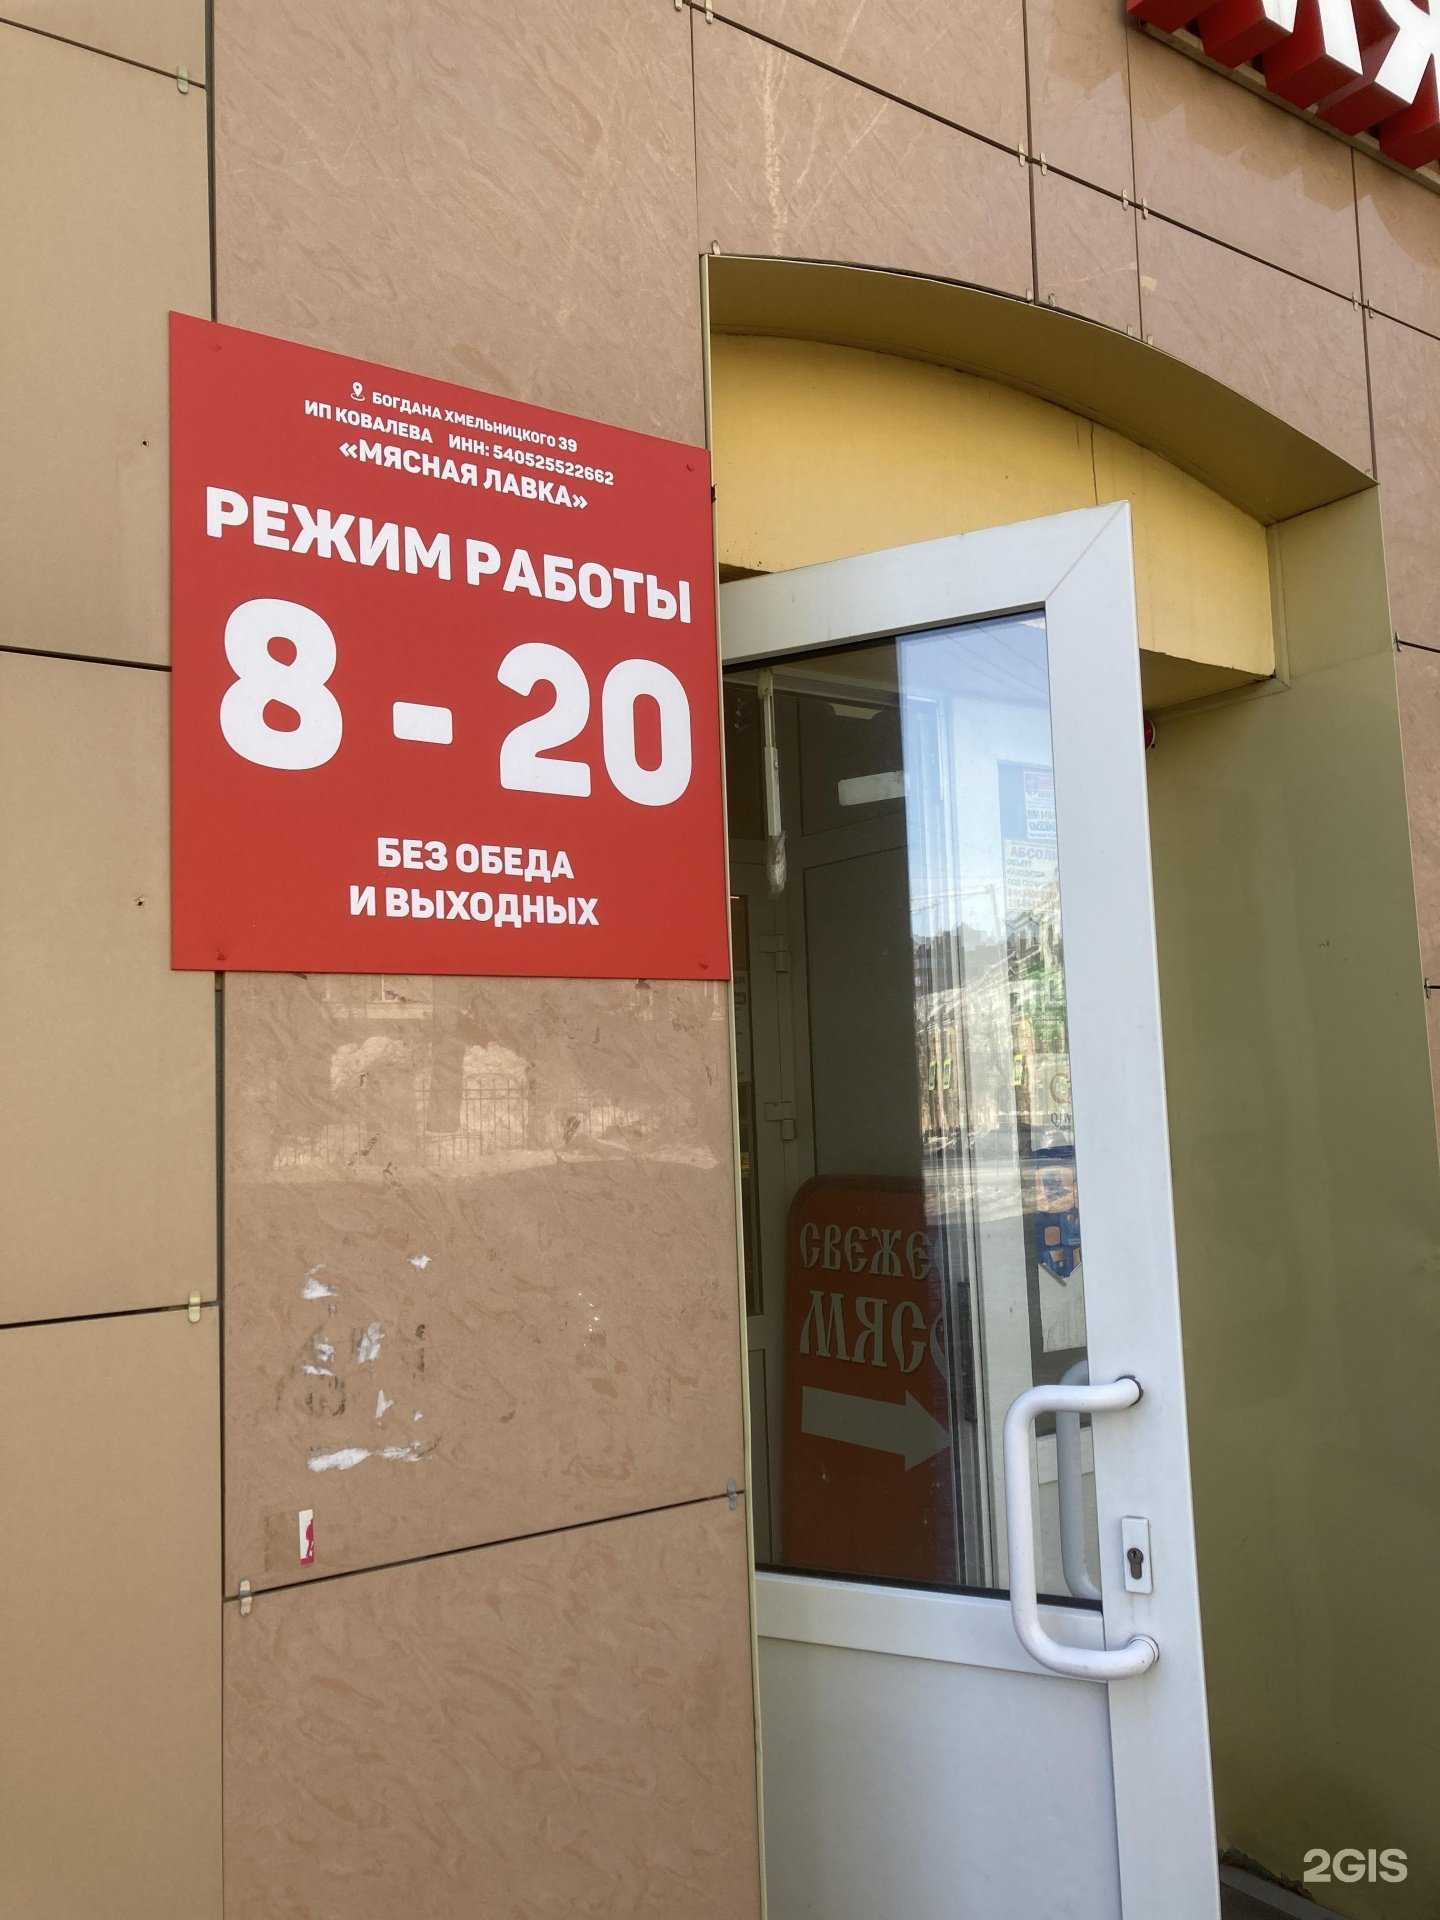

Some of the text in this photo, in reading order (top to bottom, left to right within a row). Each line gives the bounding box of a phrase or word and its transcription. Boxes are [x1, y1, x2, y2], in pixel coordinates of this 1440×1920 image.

[304, 399, 615, 486] ИП КОВАЛЕВА ИНН: 540525522662
[371, 391, 578, 453] БОГДАНА ХМЕЛЬНИЦКОГО 39
[338, 438, 590, 511] «МЯСНАЯ ЛАВКА»
[206, 486, 692, 625] РЕЖИМ РАБОТЫ
[219, 598, 693, 807] 8 - 20
[377, 837, 575, 884] БЕЗ ОБЕДА
[349, 884, 600, 929] И ВЫХОДНЫХ
